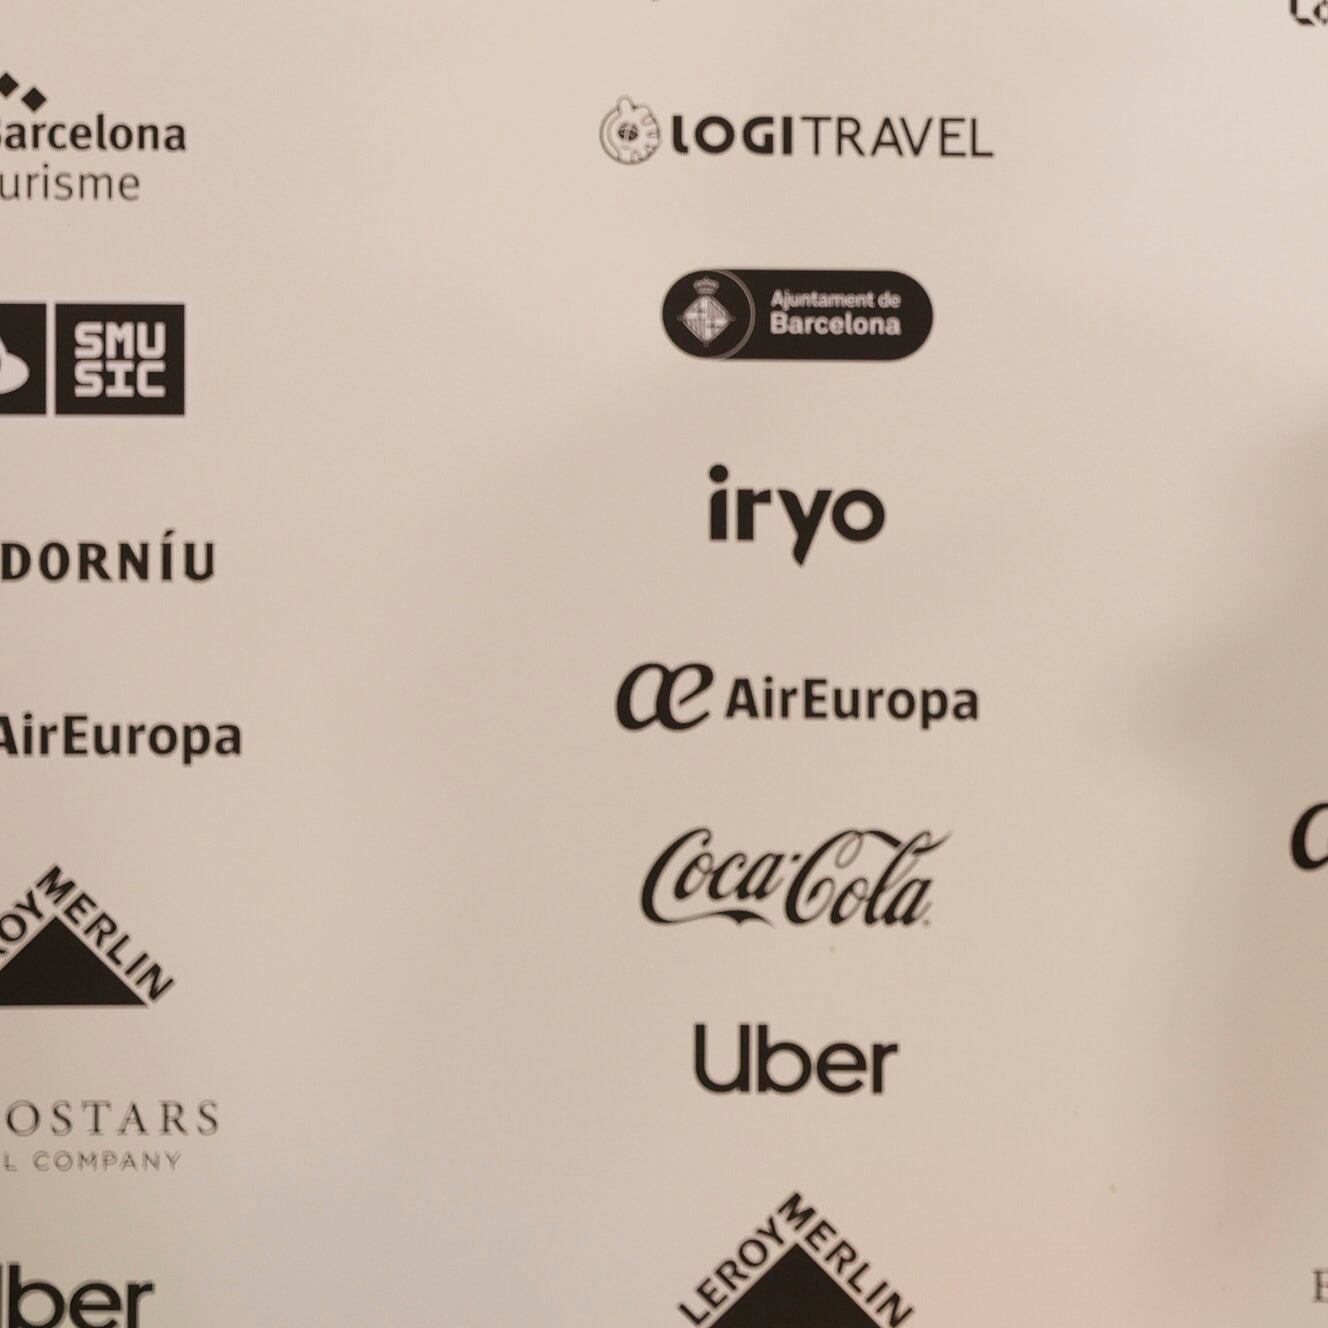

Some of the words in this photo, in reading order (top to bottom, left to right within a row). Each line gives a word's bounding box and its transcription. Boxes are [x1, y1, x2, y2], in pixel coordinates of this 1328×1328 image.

[0, 113, 187, 151] arcelona
[671, 113, 994, 159] LOGITRAVEL
[0, 163, 140, 201] urisme
[770, 288, 875, 311] Ajuntament
[877, 290, 901, 308] de
[770, 310, 901, 335] Barcelona
[708, 464, 886, 566] iryo
[725, 674, 979, 730] AirEuropa
[36, 865, 175, 1001] MERLIN
[693, 1023, 898, 1095] Uber
[32, 1150, 181, 1172] COMPANY
[678, 1217, 784, 1326] LEROY
[777, 1191, 914, 1328] MERLIN
[0, 1262, 155, 1328] ber
